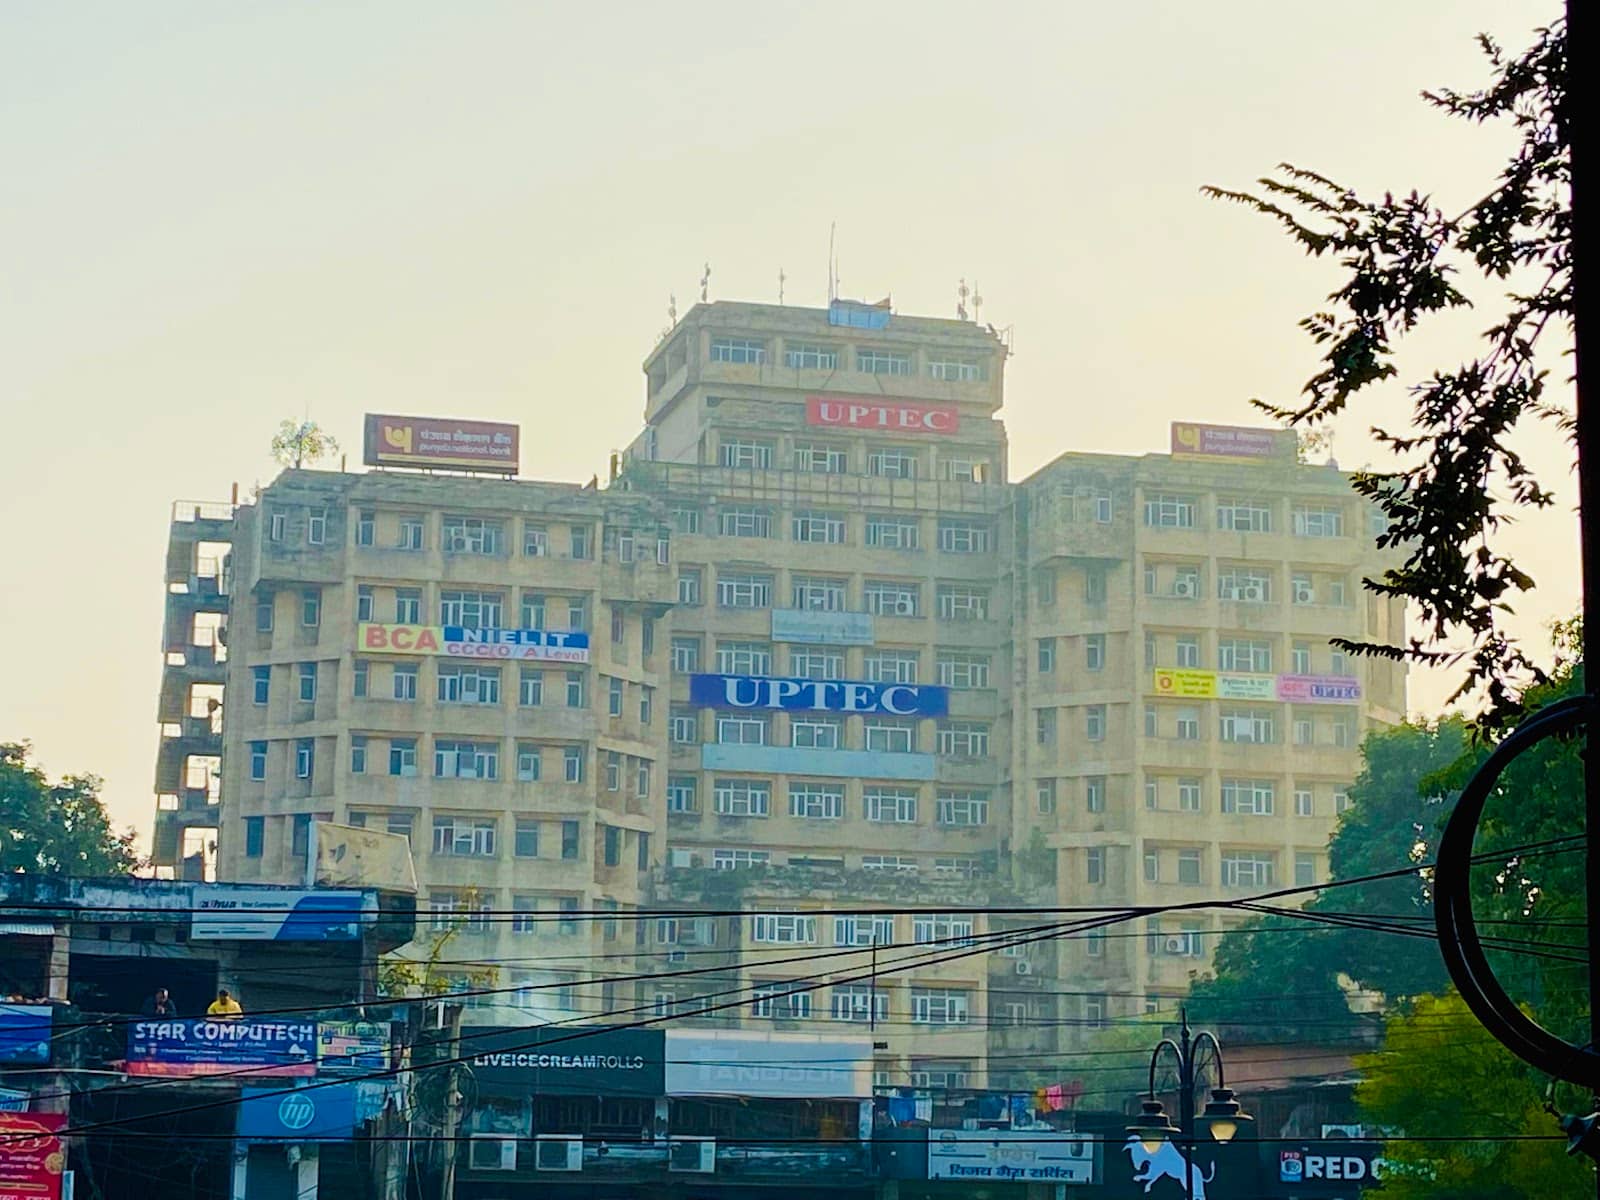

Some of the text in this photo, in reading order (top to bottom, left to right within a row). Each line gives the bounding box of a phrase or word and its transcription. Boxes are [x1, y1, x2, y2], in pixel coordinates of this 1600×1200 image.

[820, 402, 949, 430] UPTEC
[366, 626, 439, 652] BCA
[463, 628, 570, 648] NIELIT
[722, 677, 918, 715] UPTEC
[135, 1023, 185, 1041] STAR
[193, 1022, 313, 1042] COMPUTECH
[1305, 1156, 1366, 1180] RED
